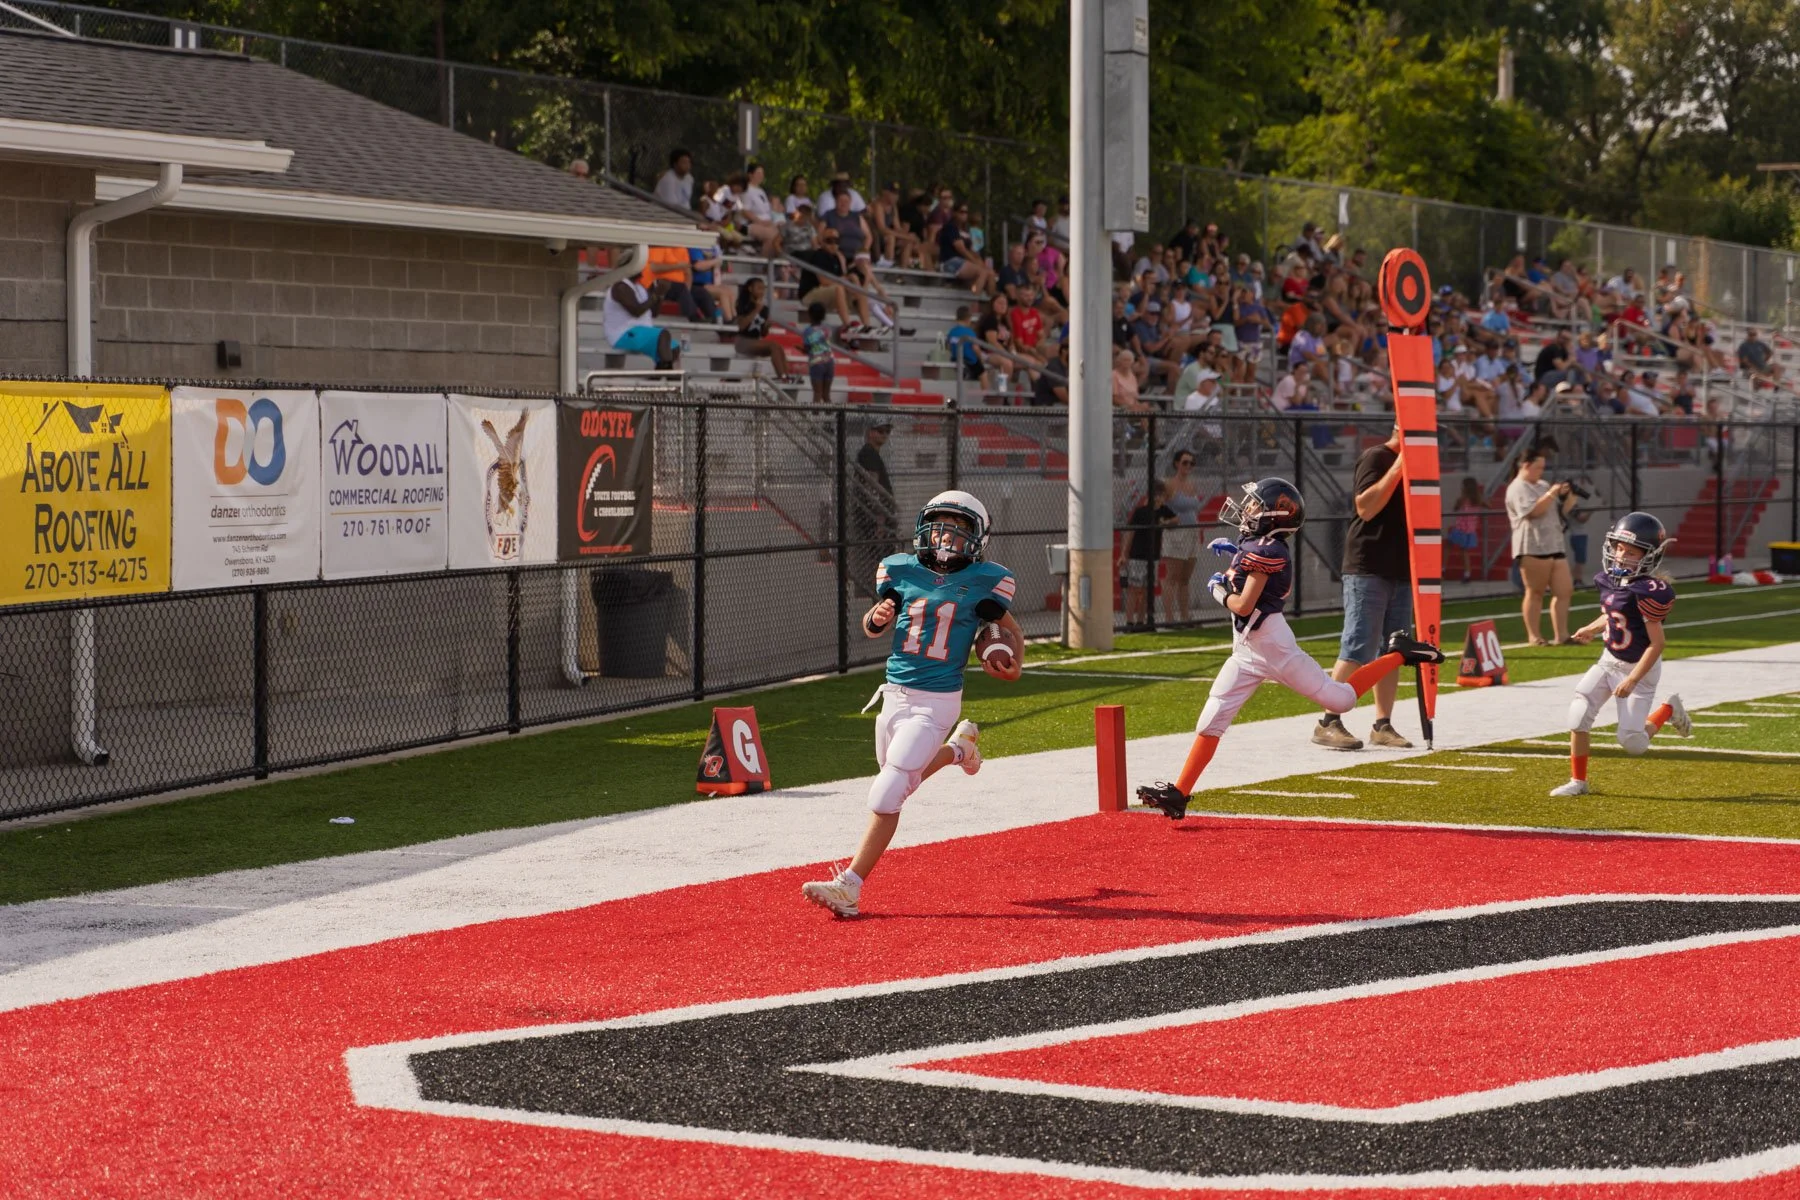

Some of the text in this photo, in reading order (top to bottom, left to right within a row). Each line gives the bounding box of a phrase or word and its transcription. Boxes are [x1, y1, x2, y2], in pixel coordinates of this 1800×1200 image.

[580, 410, 634, 438] ODCYFL
[20, 442, 149, 493] ABOVE ALL
[329, 438, 443, 476] WOODALL
[329, 486, 444, 506] COMMERCIAL ROOFING
[34, 503, 137, 554] ROOFING
[25, 556, 148, 590] 270-313-4275
[902, 598, 957, 661] 11
[1476, 629, 1504, 673] 10
[732, 719, 762, 774] G
